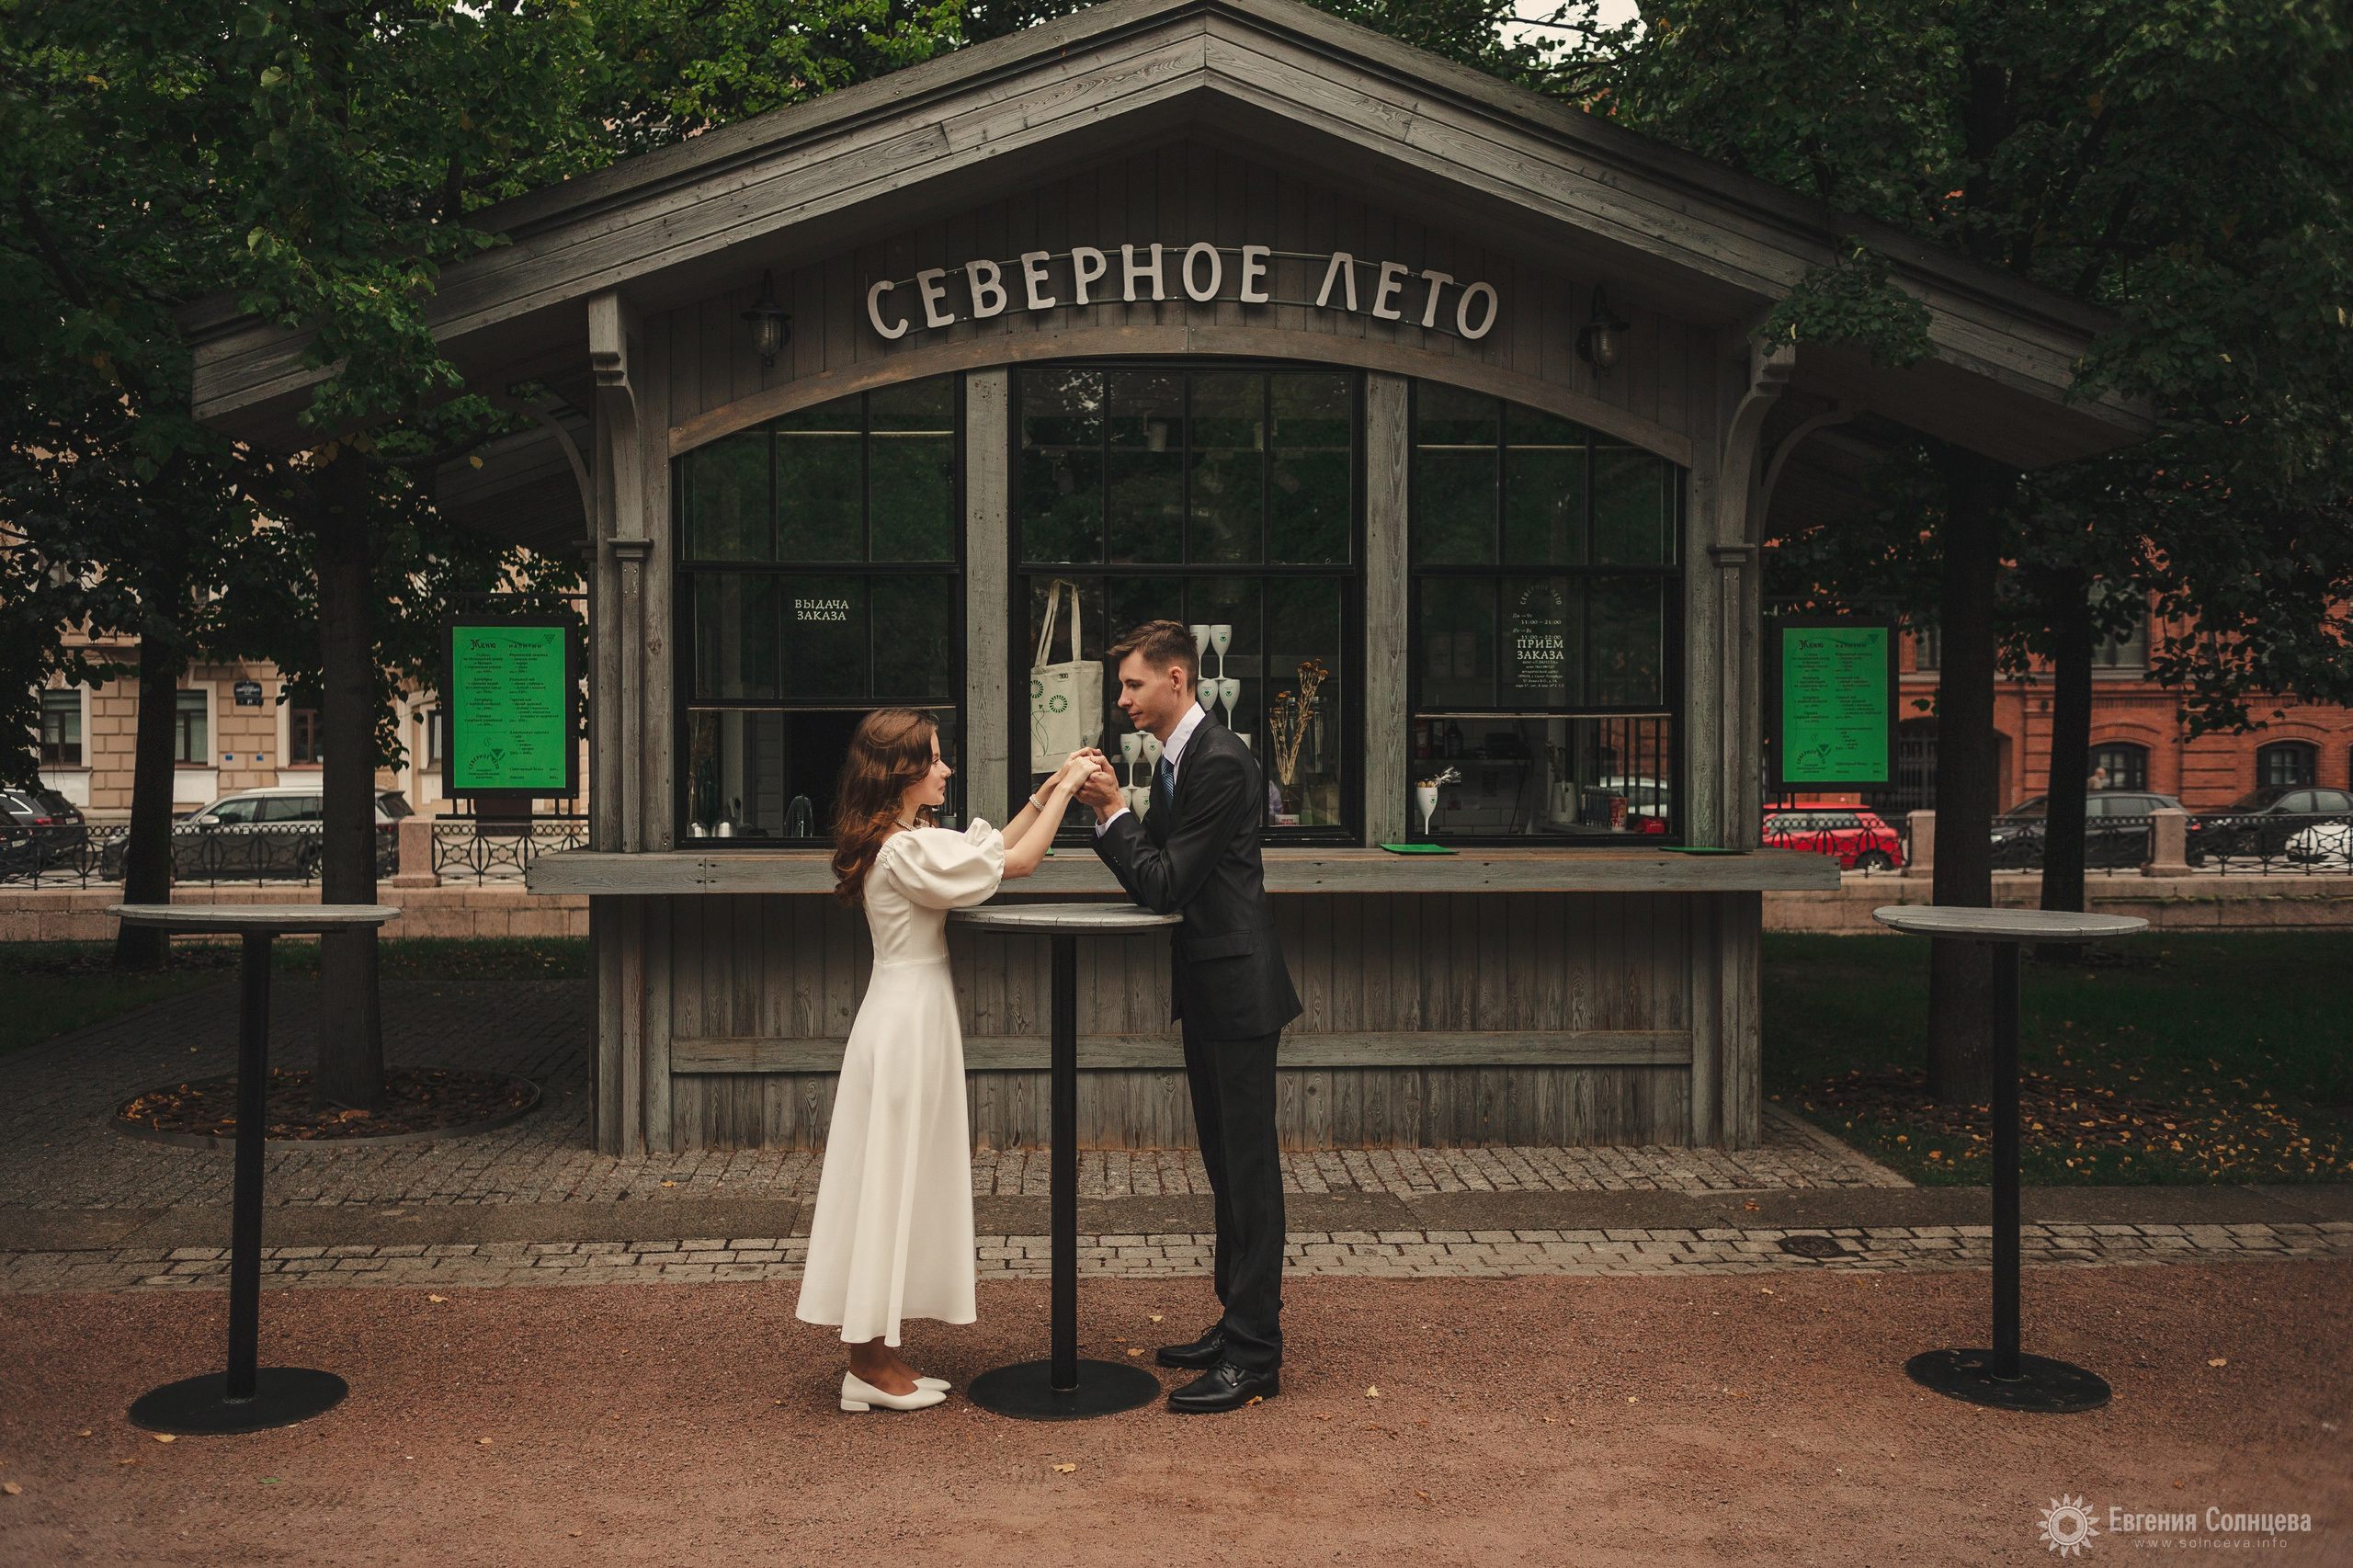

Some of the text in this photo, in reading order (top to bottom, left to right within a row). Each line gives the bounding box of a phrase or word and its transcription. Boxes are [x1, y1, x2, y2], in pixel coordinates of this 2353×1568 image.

[867, 242, 1498, 340] СЕВЕРНОЕ ЛЕТО
[794, 599, 849, 610] ВЫДАЧА
[797, 610, 847, 620] ЗАКАЗА
[470, 639, 496, 651] Меню
[1517, 639, 1564, 649] ПРИЕМ
[1799, 640, 1824, 651] Меню
[1517, 650, 1564, 660] ЗАКАЗА
